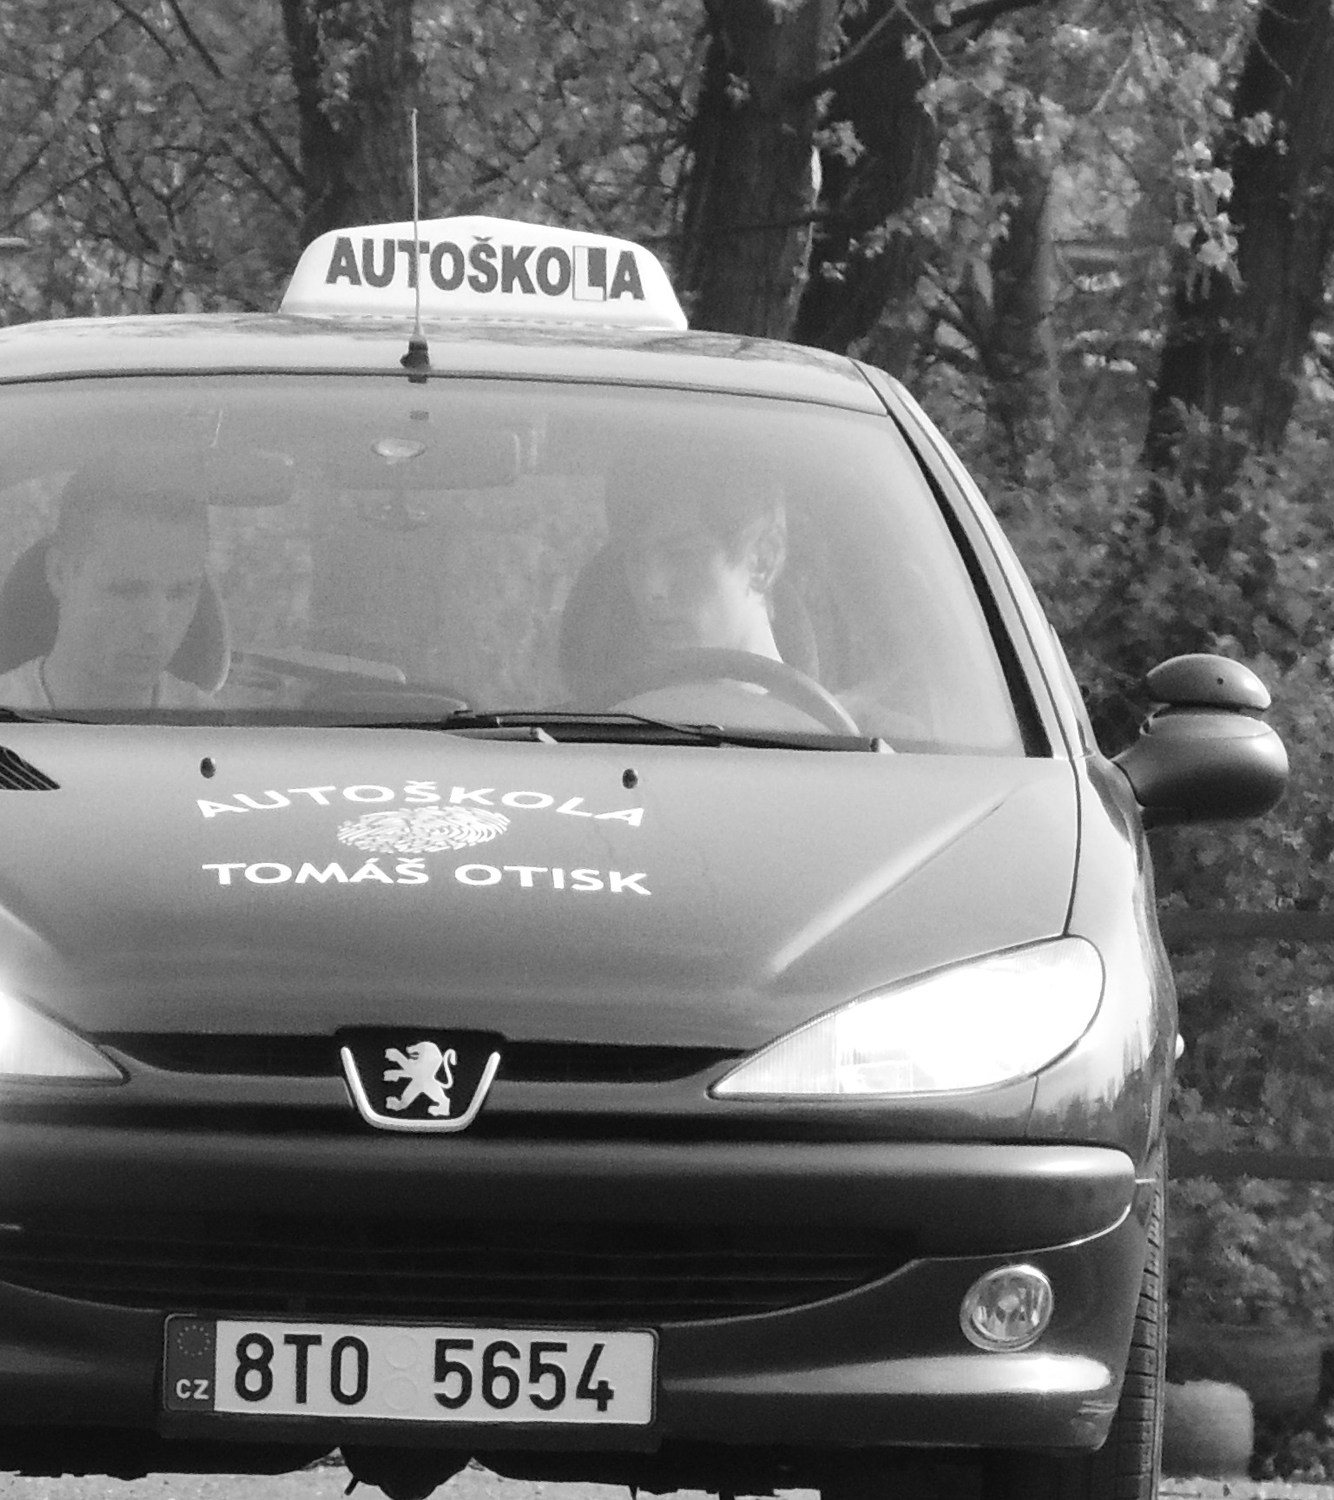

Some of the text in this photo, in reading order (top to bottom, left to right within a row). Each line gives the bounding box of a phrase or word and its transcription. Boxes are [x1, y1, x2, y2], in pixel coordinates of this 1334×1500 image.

[325, 235, 645, 301] AUTOŠKOLA
[196, 779, 645, 827] AUTOŠKOLA
[201, 857, 653, 896] TOMÁŠ OTISK
[175, 1378, 210, 1400] CZ
[234, 1332, 615, 1413] 8T0 5654
